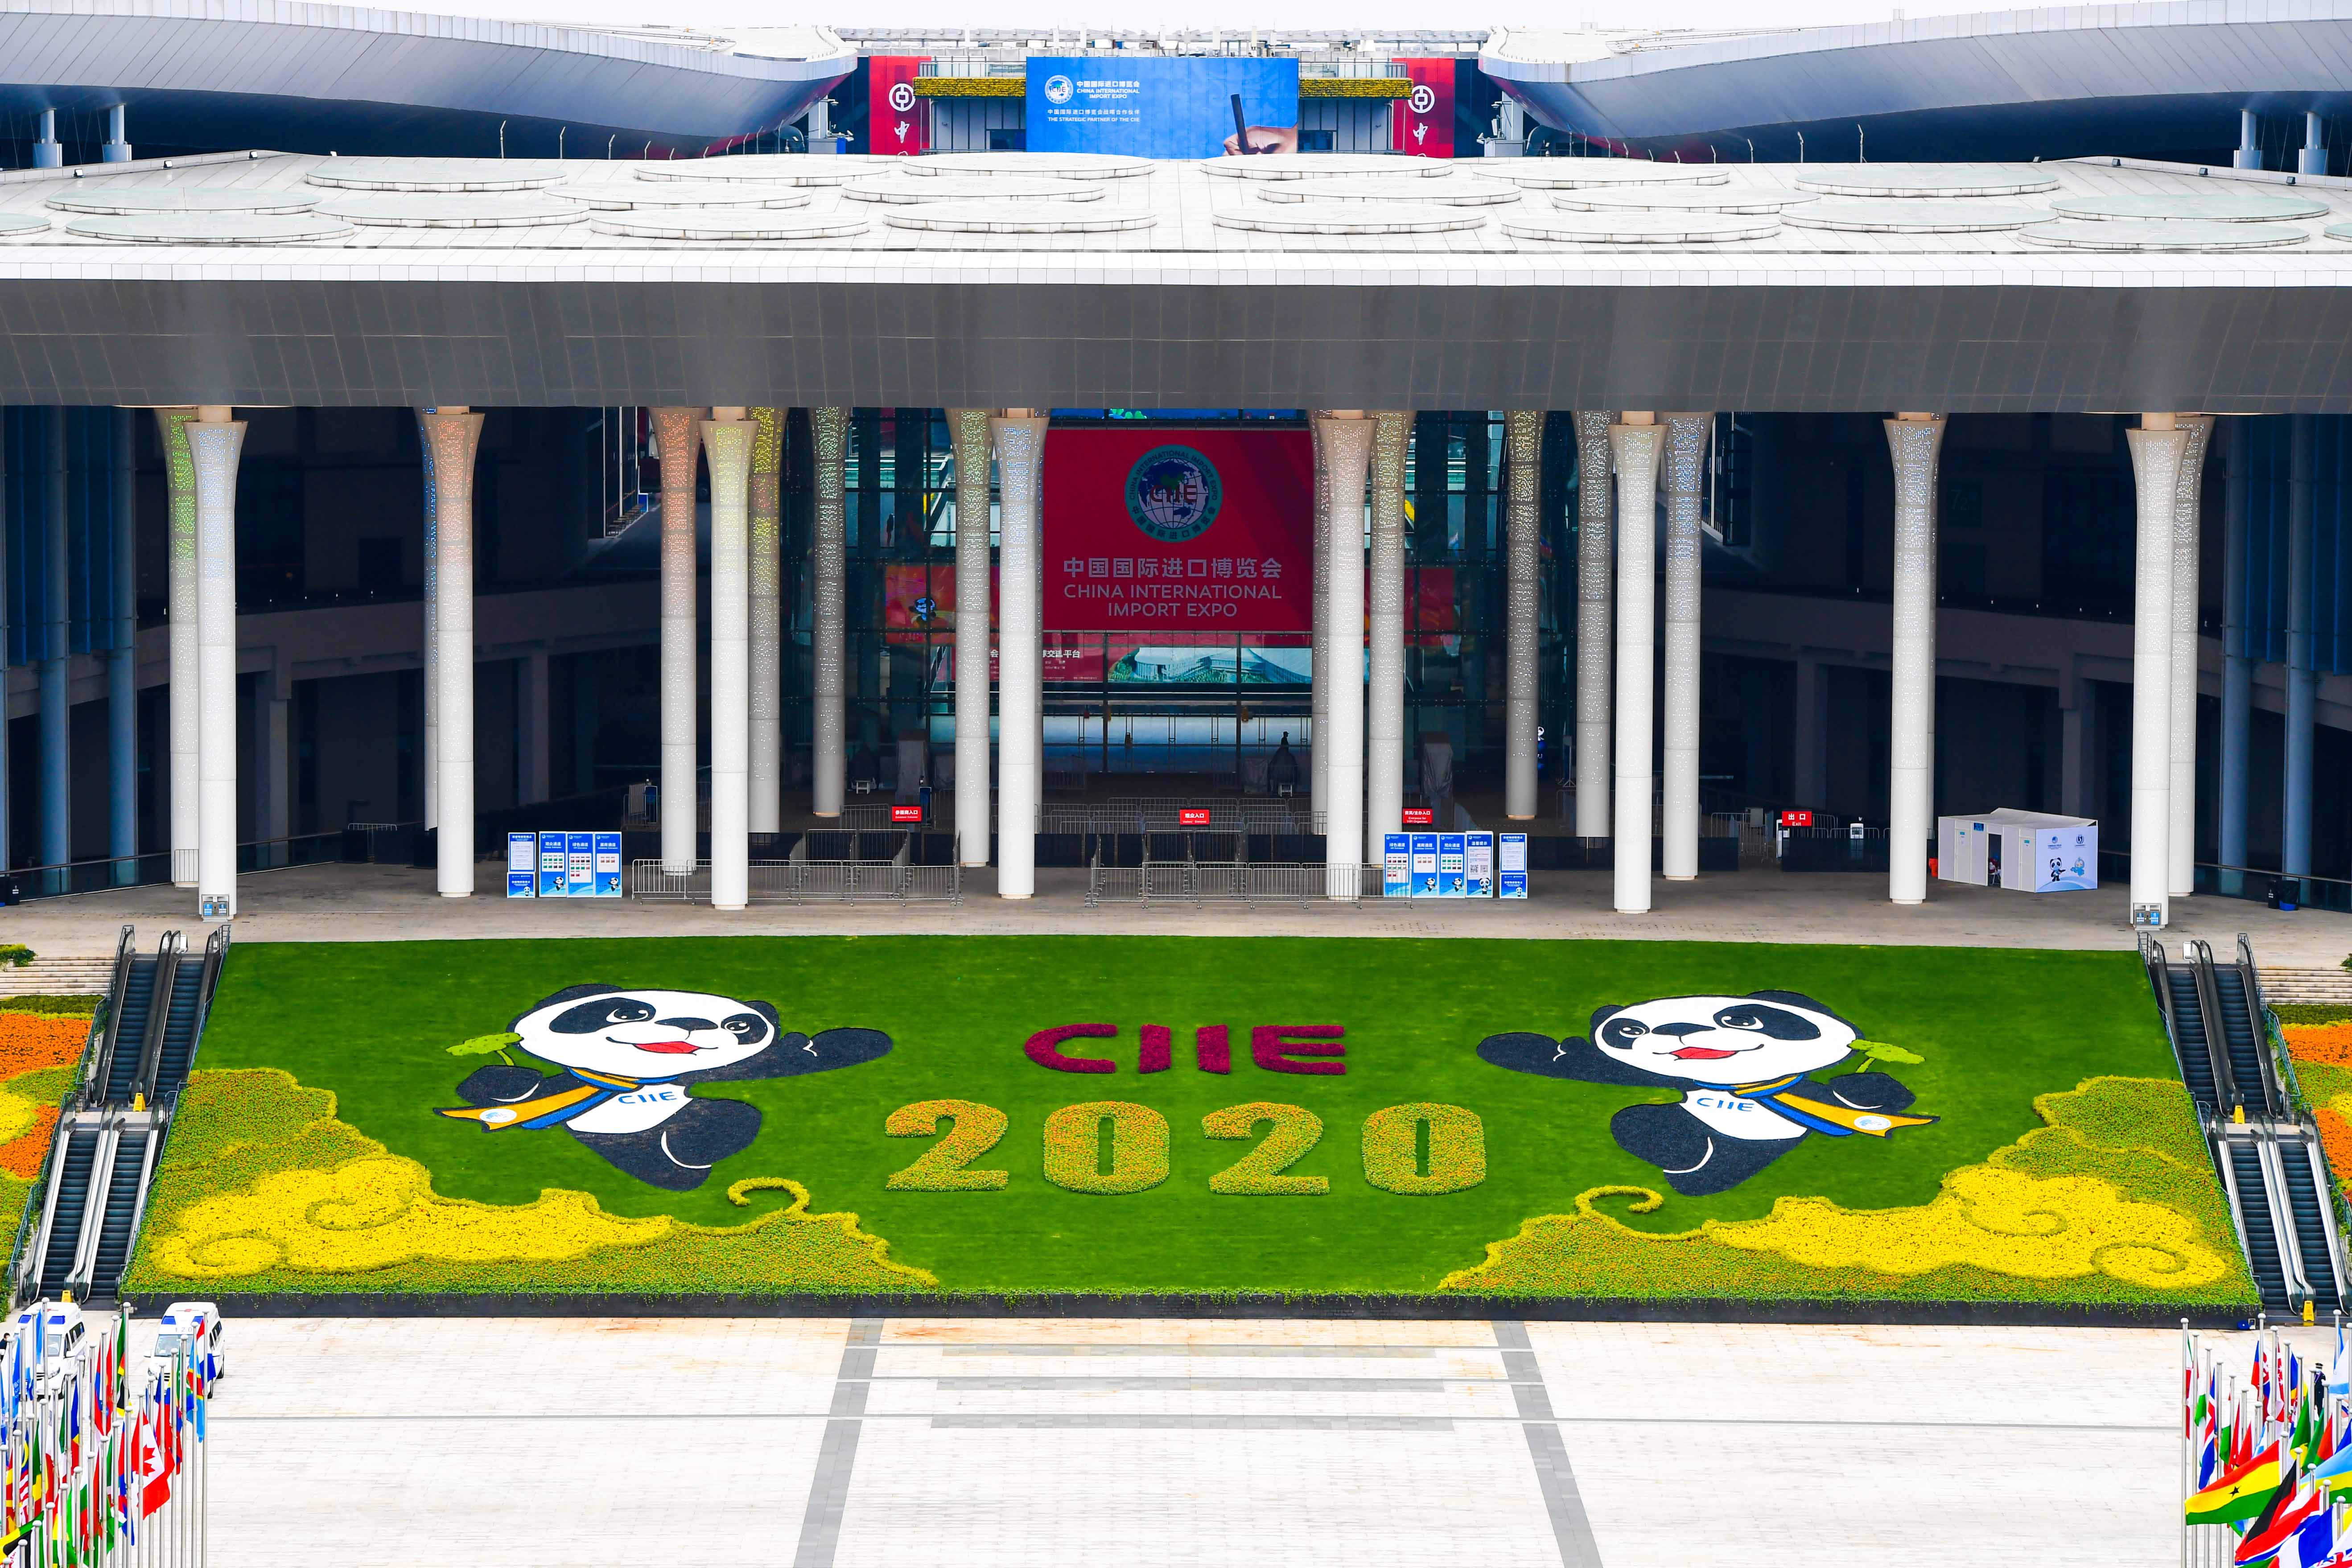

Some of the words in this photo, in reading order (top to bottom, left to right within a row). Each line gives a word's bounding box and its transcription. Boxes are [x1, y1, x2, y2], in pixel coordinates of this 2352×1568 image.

[1129, 477, 1138, 500] CHINA
[1136, 450, 1189, 477] INTERNATIONAL
[1191, 456, 1214, 479] IMPORT
[1210, 480, 1218, 501] EXPO
[1150, 485, 1197, 503] CIIE
[1063, 556, 1282, 578] 中国国际进口博览会
[1064, 584, 1125, 598] CHINA
[1130, 584, 1282, 599] INTERNATIONAL
[1108, 602, 1181, 617] IMPORT
[1187, 602, 1238, 617] EXPO
[1024, 1023, 1346, 1075] CIIE
[618, 1091, 677, 1104] CIIE
[1697, 1098, 1755, 1112] CIIE
[885, 1099, 1487, 1196] 2020
